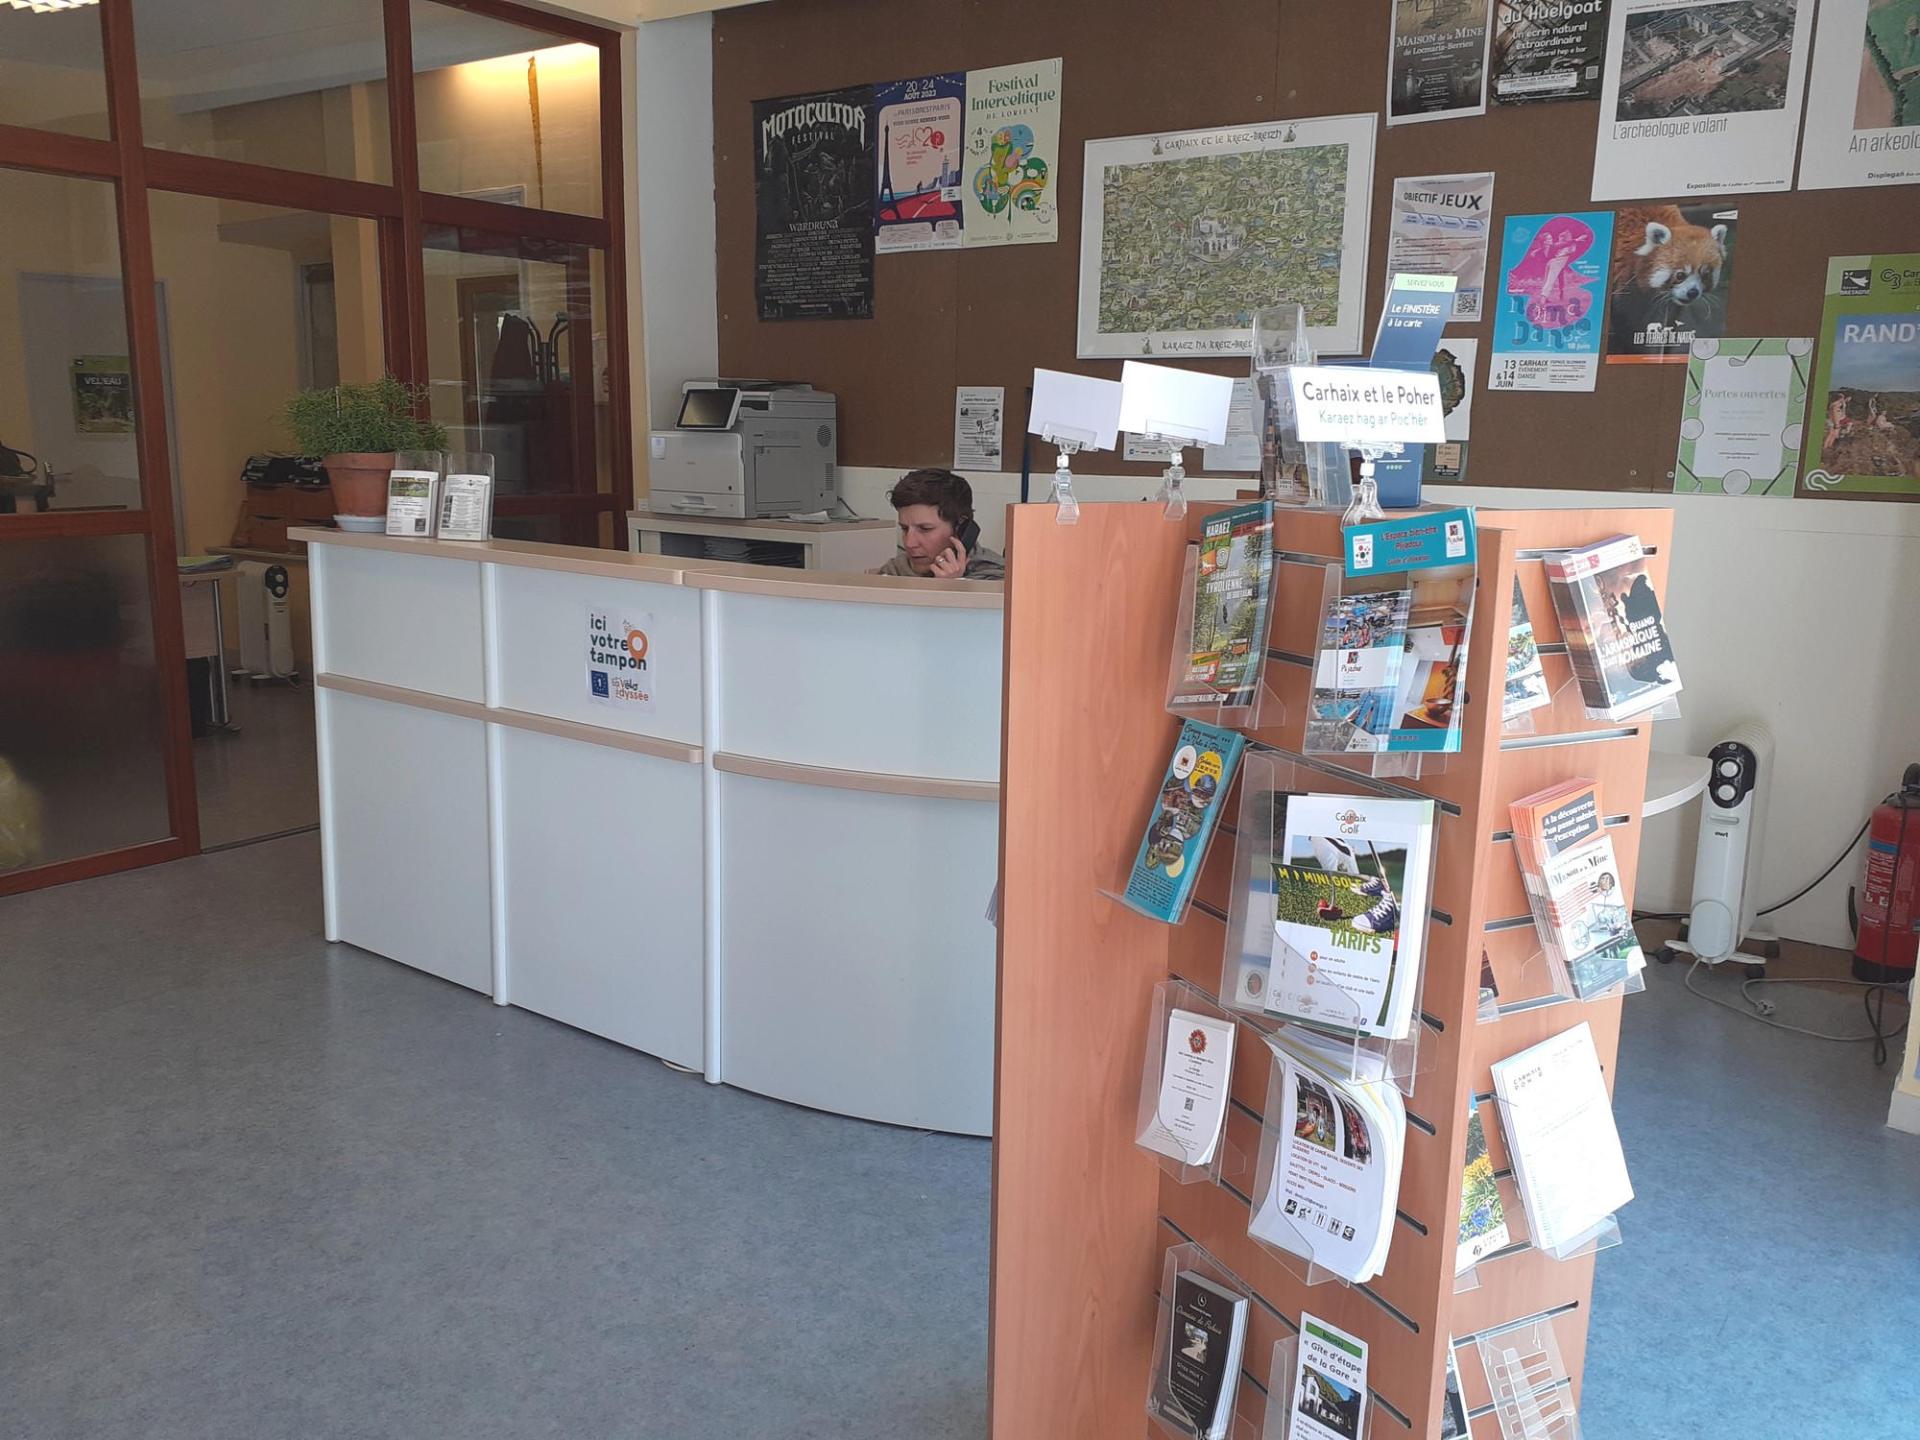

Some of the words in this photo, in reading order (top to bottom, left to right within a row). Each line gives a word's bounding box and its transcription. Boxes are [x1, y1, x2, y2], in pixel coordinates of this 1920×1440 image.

[1503, 8, 1522, 24] du
[1529, 0, 1602, 20] Huelgoat
[1455, 26, 1484, 39] MINE
[1552, 21, 1587, 34] naturel
[1516, 36, 1582, 50] extraordinaire
[906, 81, 917, 92] 20
[922, 79, 935, 91] 24
[989, 73, 1038, 93] Festival
[971, 90, 1056, 111] Interceltique
[1002, 107, 1039, 118] LORIENT
[762, 102, 866, 163] MOTOCULTOR
[977, 127, 983, 135] 4
[1692, 118, 1728, 133] volant
[792, 131, 834, 145] FESTIVAL
[975, 139, 984, 148] 13
[1848, 134, 1868, 152] An
[1404, 192, 1438, 204] OBJECTIF
[1440, 194, 1482, 210] JEUX
[1391, 304, 1401, 312] Le
[1387, 318, 1393, 327] à
[1394, 319, 1402, 327] la
[1403, 319, 1423, 328] carte
[1634, 332, 1644, 344] LES
[1646, 332, 1668, 344] TERRES
[1669, 332, 1676, 344] DE
[1504, 360, 1516, 369] 13
[1503, 371, 1514, 380] 14
[1302, 381, 1360, 402] Carhaix
[1365, 386, 1378, 404] et
[1382, 385, 1393, 404] le
[1397, 386, 1435, 406] Poher
[1704, 389, 1737, 398] Portes
[1740, 389, 1786, 398] ouvertes
[1319, 411, 1353, 424] Karaez
[1356, 411, 1375, 428] hag
[1379, 415, 1388, 425] ar
[590, 614, 606, 631] ici
[1629, 616, 1655, 632] QUAND
[590, 634, 629, 651] votre
[590, 648, 646, 670] tampon
[1336, 812, 1366, 823] Carhaix
[1550, 815, 1557, 823] la
[1558, 801, 1594, 819] découverte
[1340, 823, 1359, 834] Golf
[1588, 854, 1608, 867] Mine
[1303, 872, 1330, 884] MINI
[1331, 876, 1361, 887] GOLF
[1331, 928, 1381, 954] TARIFS
[1311, 1342, 1327, 1356] Gîte
[1330, 1352, 1362, 1373] d'étape
[1307, 1353, 1318, 1363] de
[1320, 1359, 1327, 1368] la
[1329, 1365, 1350, 1380] Gare
